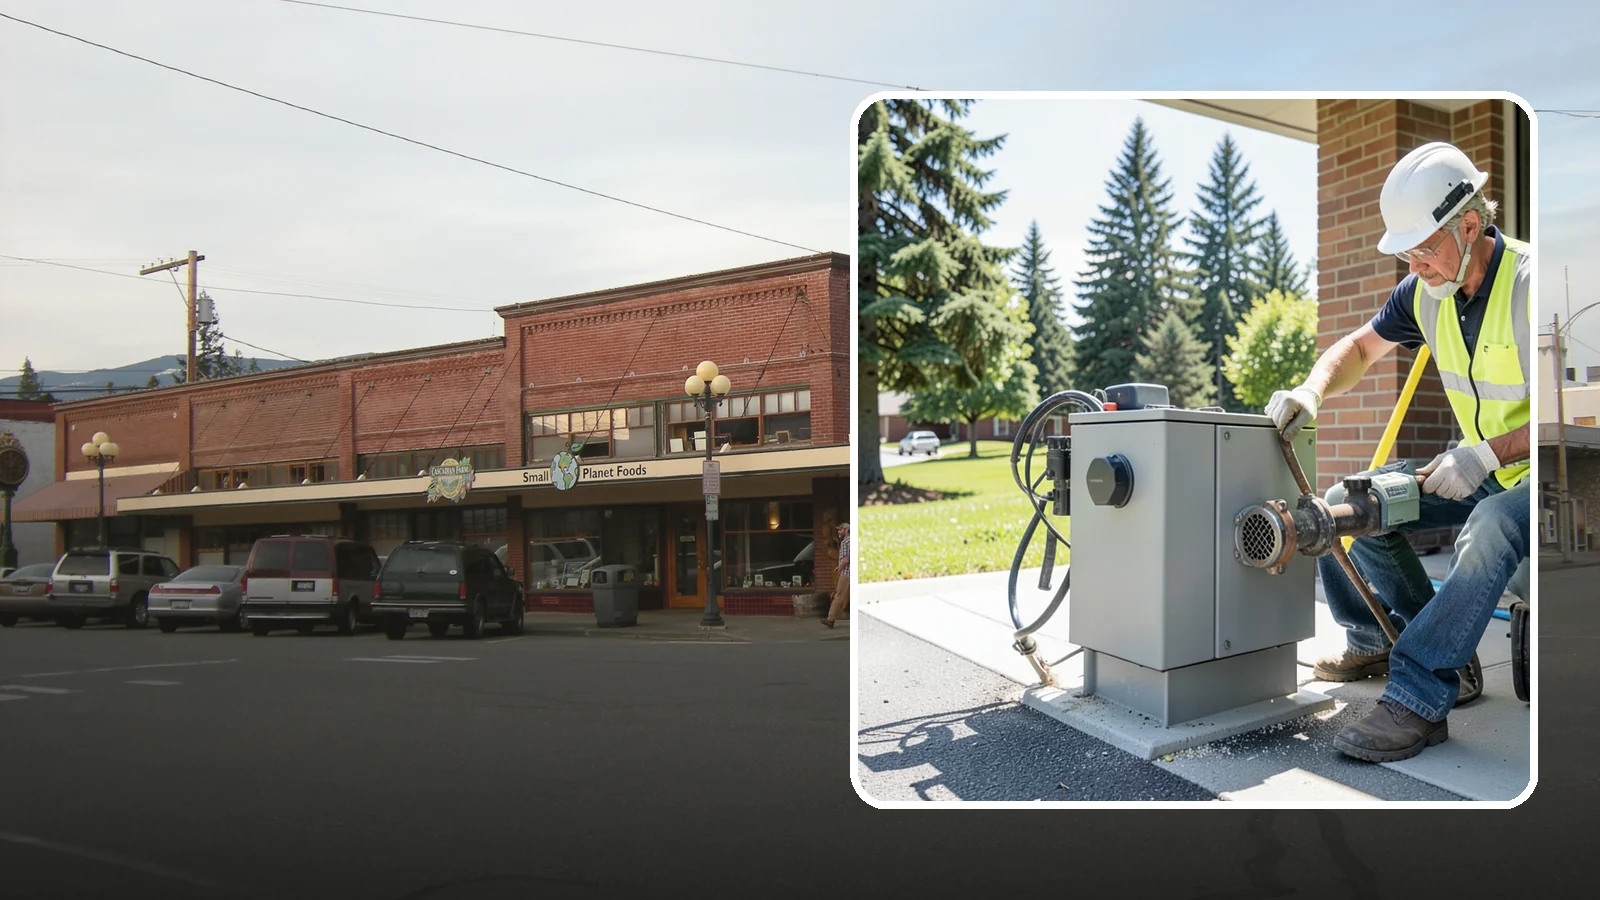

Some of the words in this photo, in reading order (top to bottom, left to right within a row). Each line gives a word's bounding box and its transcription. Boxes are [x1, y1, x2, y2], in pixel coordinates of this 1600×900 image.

[523, 471, 549, 483] Small
[583, 467, 614, 479] Planet
[617, 464, 647, 477] Foods
